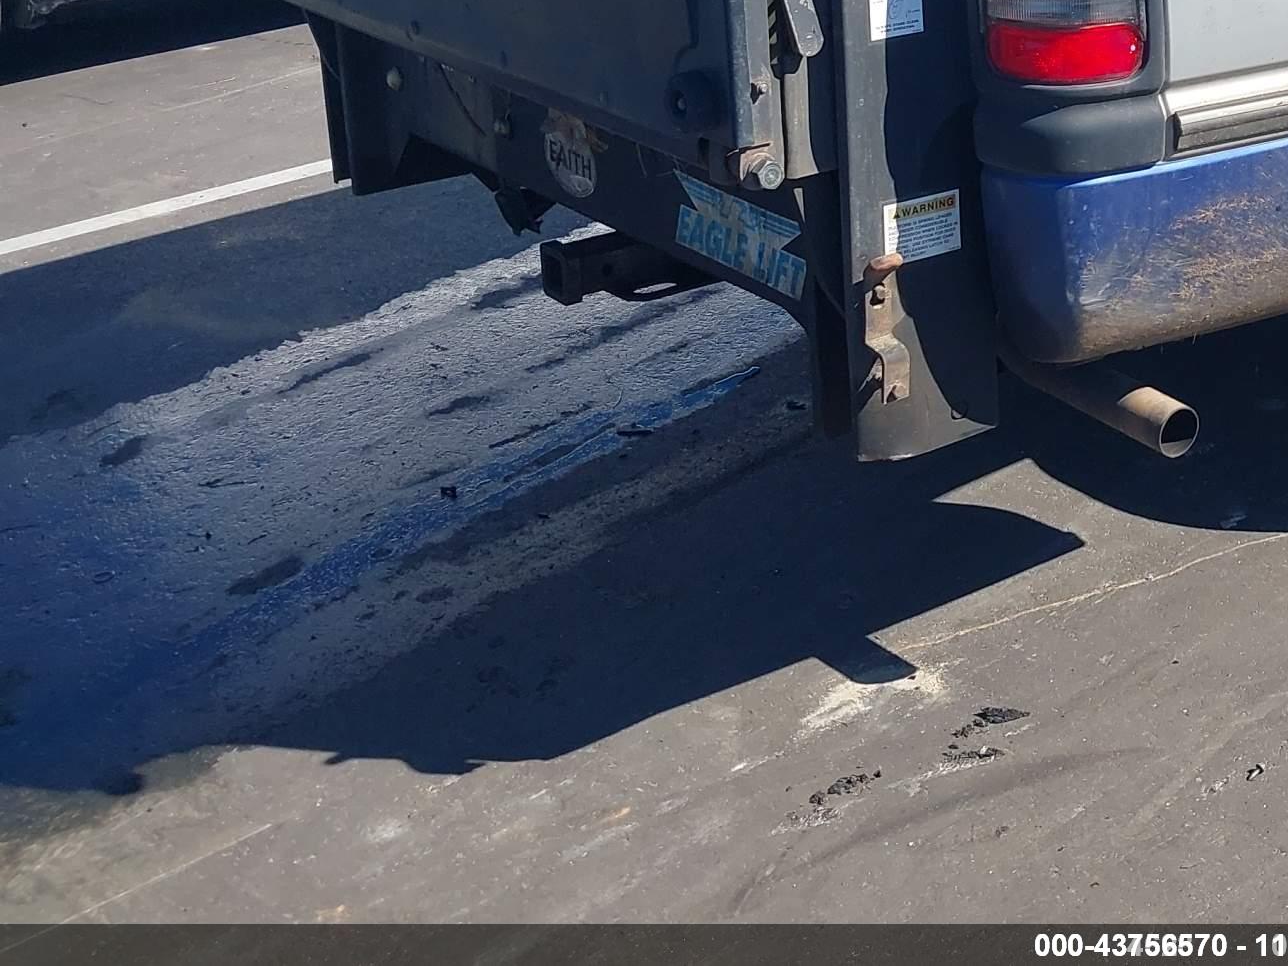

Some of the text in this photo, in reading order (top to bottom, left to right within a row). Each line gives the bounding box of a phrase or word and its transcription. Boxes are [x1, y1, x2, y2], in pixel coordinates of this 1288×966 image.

[901, 197, 955, 217] WARNING
[678, 204, 806, 298] EAGLE LIFT
